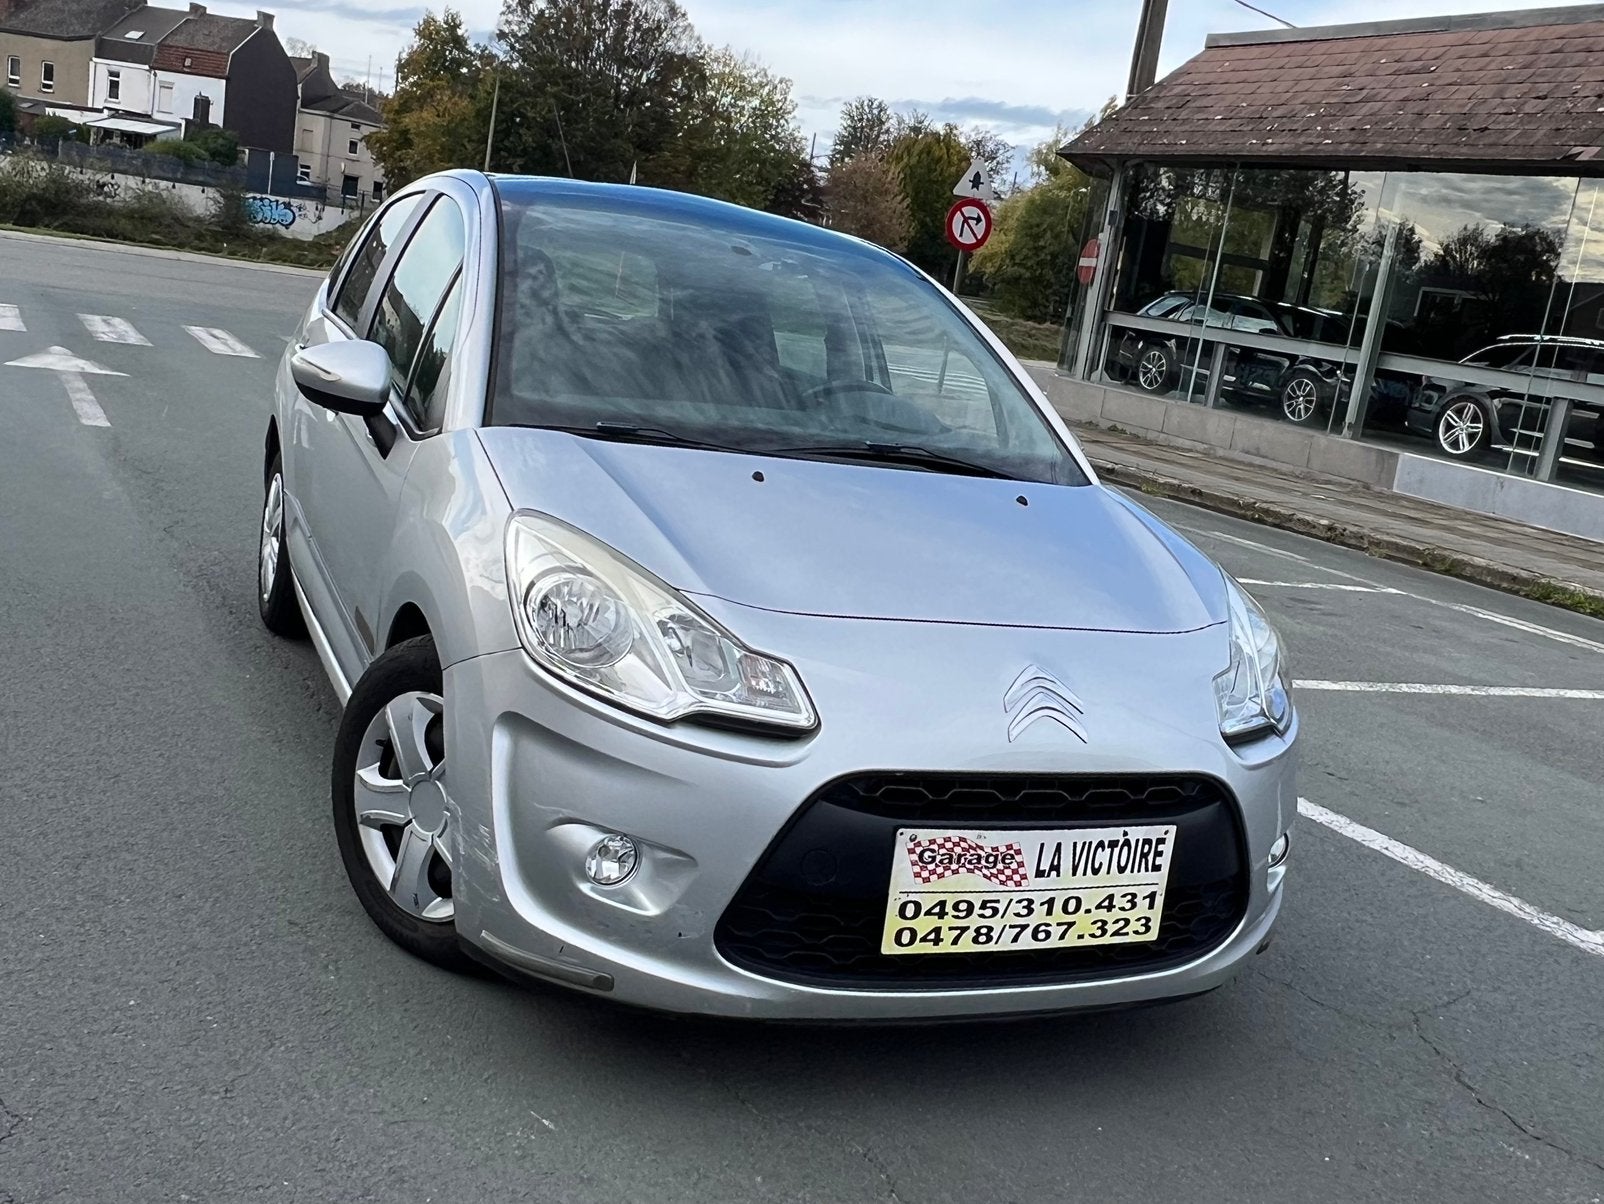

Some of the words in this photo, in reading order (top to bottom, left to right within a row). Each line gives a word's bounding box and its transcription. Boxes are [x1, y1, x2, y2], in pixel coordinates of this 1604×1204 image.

[918, 847, 1016, 870] Garage
[1034, 842, 1062, 878] LA
[898, 891, 1157, 920] 0495/310.431
[894, 916, 1152, 947] 0478/767.323
